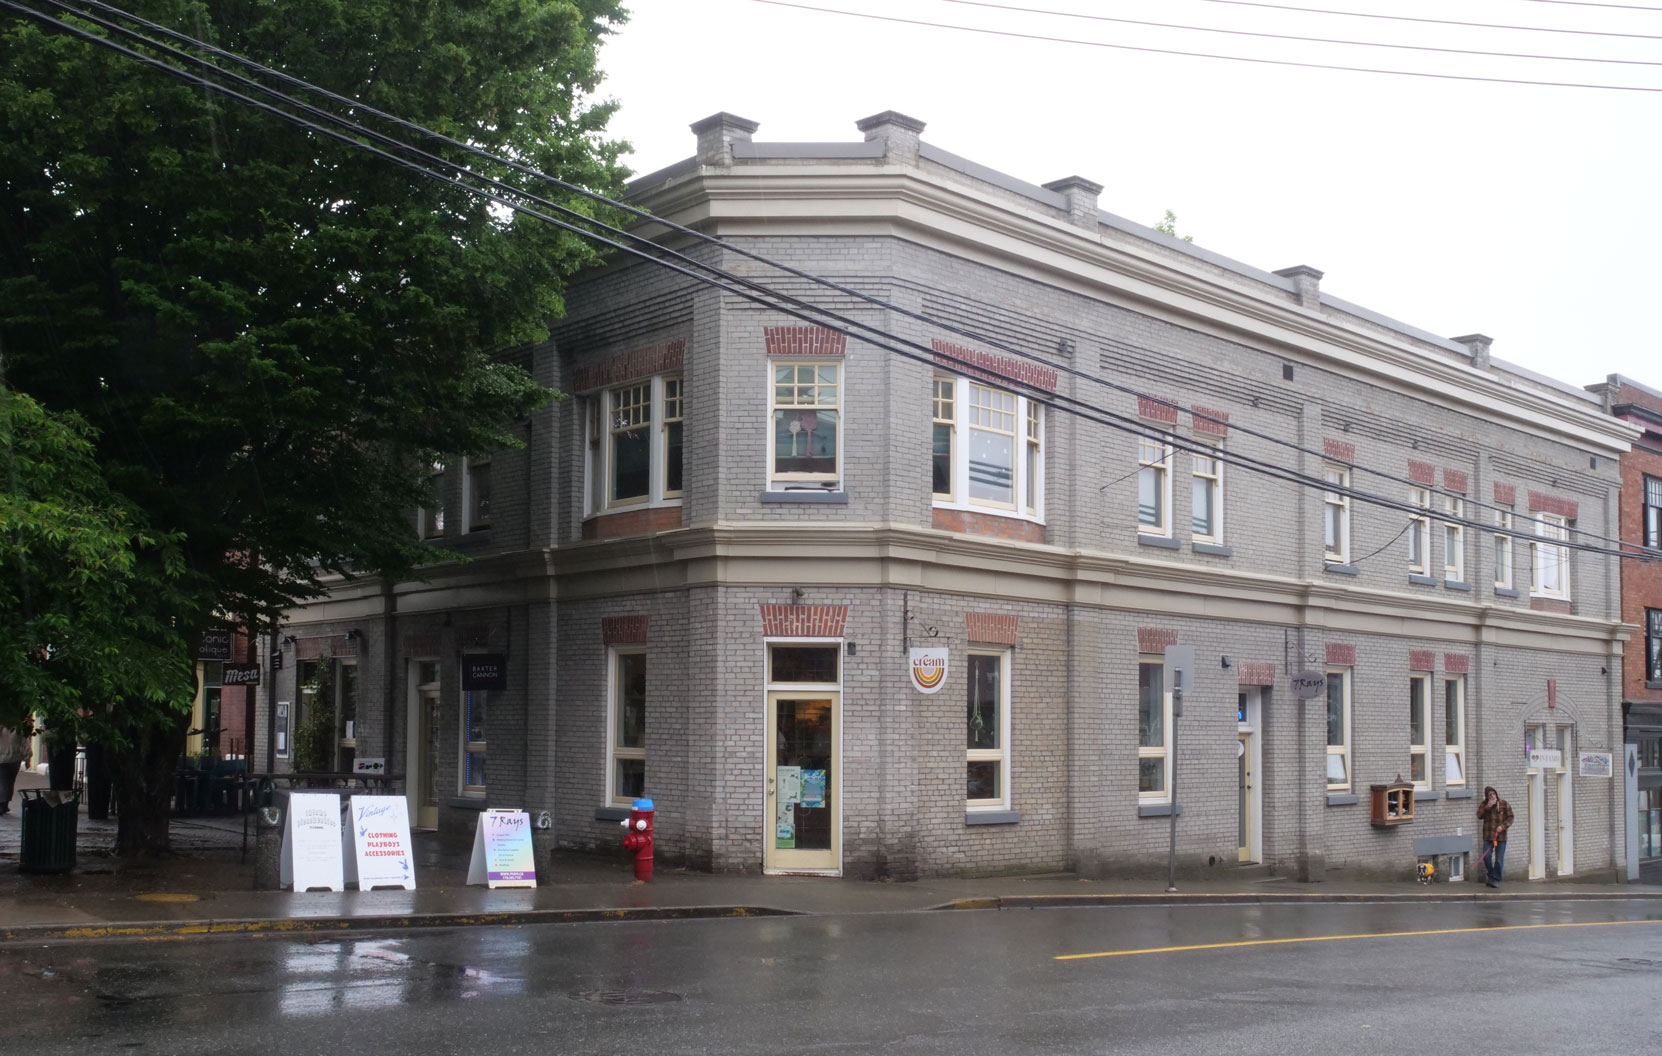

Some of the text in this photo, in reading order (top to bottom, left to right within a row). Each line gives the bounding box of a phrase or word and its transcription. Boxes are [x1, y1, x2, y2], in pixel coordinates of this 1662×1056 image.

[913, 654, 944, 666] cream
[225, 669, 258, 683] Mesa
[358, 803, 392, 822] Vintage
[490, 815, 524, 832] 7 Rays
